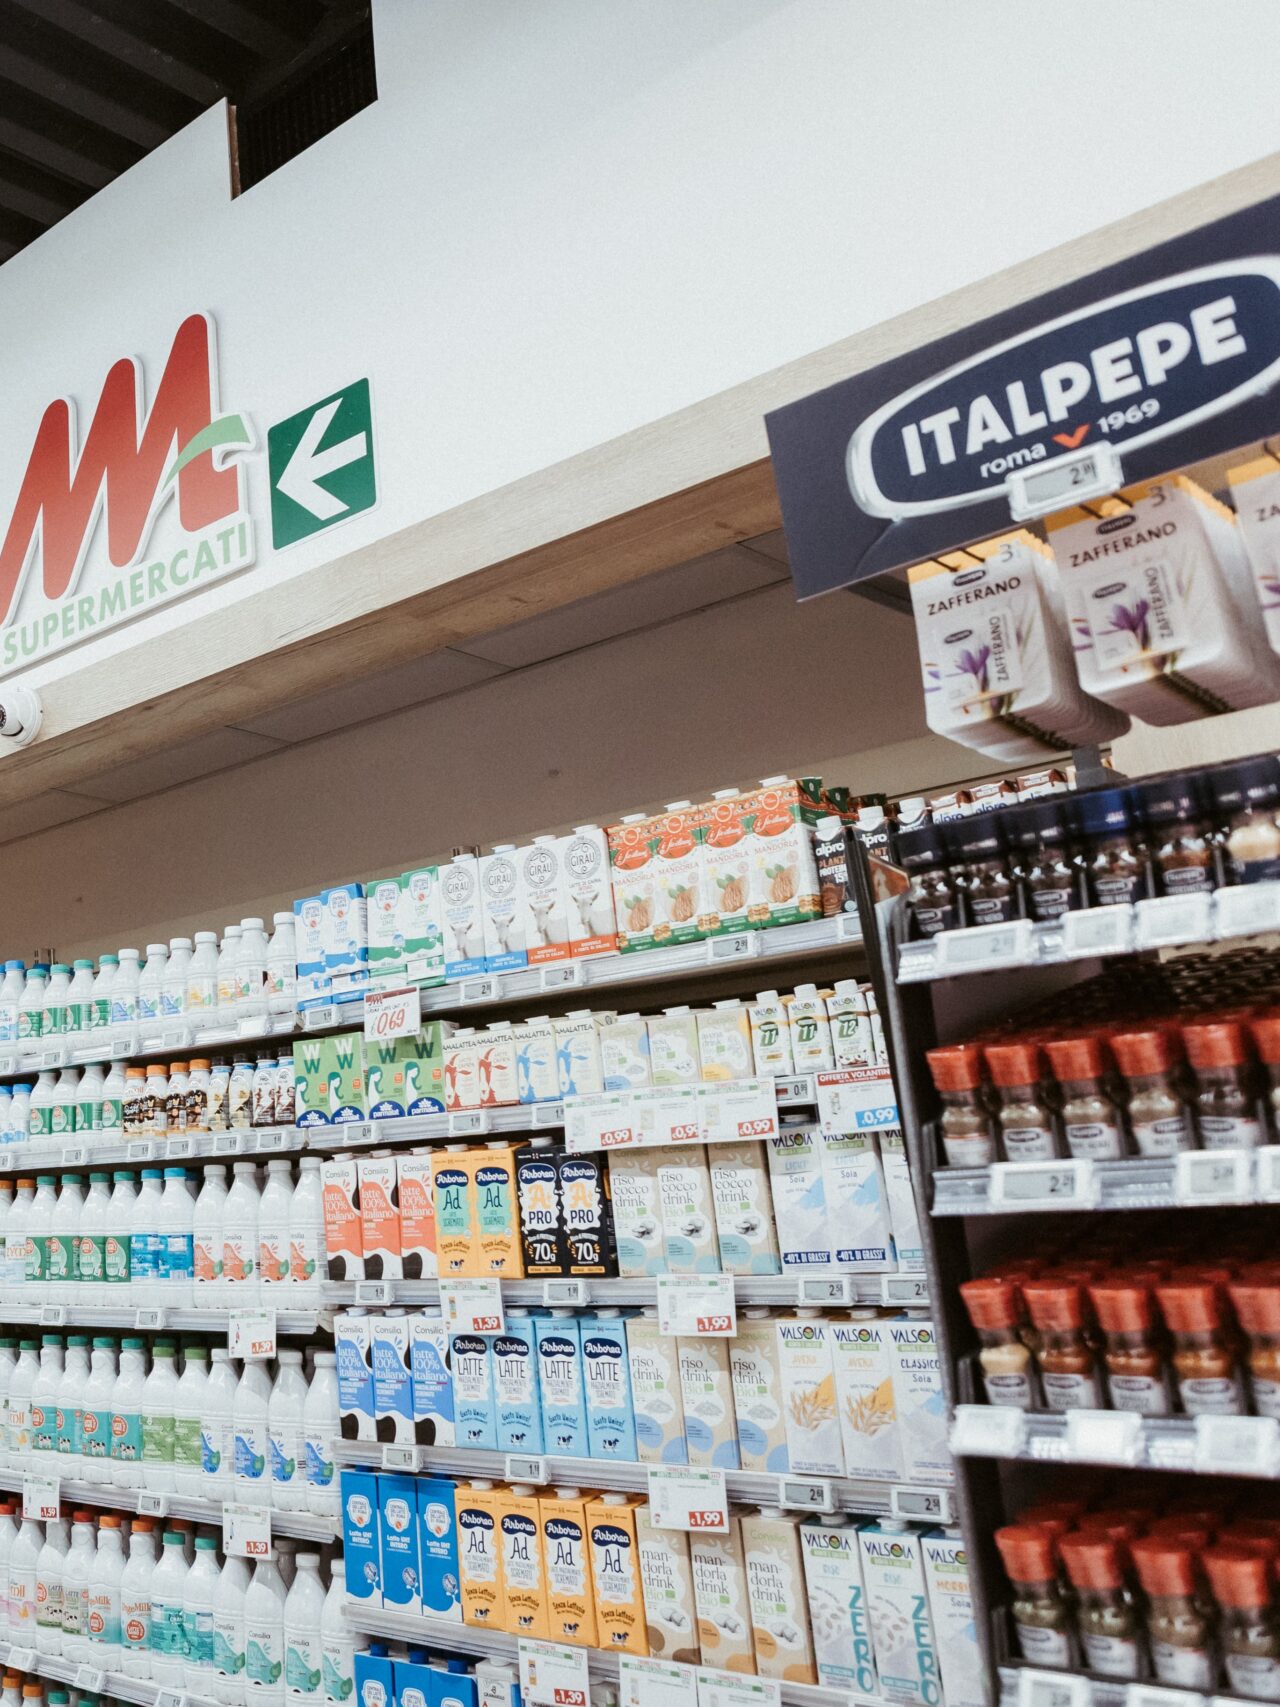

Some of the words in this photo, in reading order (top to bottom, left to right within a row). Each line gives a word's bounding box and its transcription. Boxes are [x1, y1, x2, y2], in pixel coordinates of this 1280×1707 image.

[901, 296, 1247, 476] ITALPEPE
[980, 443, 1048, 478] roma
[1097, 398, 1162, 433] 1969
[1068, 520, 1177, 568] ZAFFERANO
[927, 575, 1021, 616] ZAFFERANO
[1145, 565, 1174, 639] ZAFFERANO
[988, 616, 1010, 683] ZAFFERANO
[815, 841, 845, 857] alpro
[819, 1072, 850, 1083] OFFERTA
[852, 1067, 891, 1079] VOLANTIN
[771, 1132, 813, 1149] VALSOIA
[325, 1169, 349, 1179] Consilia
[362, 1165, 389, 1176] Consilia
[402, 1163, 430, 1173] Consilia
[521, 1167, 554, 1180] Arborea
[562, 1165, 595, 1178] Arborea
[713, 1167, 737, 1180] riso
[436, 1172, 468, 1185] Arborea
[477, 1169, 509, 1182] Arborea
[612, 1174, 635, 1186] riso
[660, 1171, 684, 1182] riso
[613, 1184, 649, 1196] cocco
[661, 1181, 697, 1193] cocco
[714, 1178, 752, 1190] cocco
[324, 1191, 342, 1201] latte
[361, 1189, 381, 1199] latte
[401, 1186, 421, 1196] latte
[716, 1188, 748, 1202] drink
[325, 1200, 348, 1211] 100%
[363, 1198, 386, 1209] 100%
[401, 1195, 426, 1207] 100%
[614, 1194, 646, 1207] drink
[662, 1192, 694, 1206] drink
[326, 1210, 355, 1221] italiano
[363, 1208, 393, 1219] italiano
[401, 1206, 434, 1217] italiano
[528, 1210, 552, 1225] PRO
[570, 1209, 594, 1224] PRO
[338, 1324, 364, 1334] Consilia
[375, 1325, 402, 1335] Consilia
[415, 1325, 444, 1335] Consilia
[780, 1326, 825, 1341] VALSOIA
[833, 1328, 882, 1343] VALSOIA
[454, 1339, 486, 1351] Arborea
[495, 1341, 528, 1353] Arborea
[541, 1341, 574, 1354] Arborea
[585, 1342, 621, 1355] Arborea
[338, 1346, 356, 1358] latte
[374, 1346, 393, 1358] latte
[413, 1347, 433, 1359] latte
[339, 1357, 361, 1368] 100%
[375, 1357, 399, 1369] 100%
[414, 1358, 440, 1370] 100%
[457, 1357, 484, 1378] LATTE
[632, 1356, 654, 1368] riso
[681, 1358, 704, 1370] riso
[732, 1359, 756, 1371] riso
[339, 1367, 368, 1379] italiano
[375, 1368, 407, 1380] italiano
[414, 1369, 448, 1381] italiano
[498, 1359, 525, 1379] LATTE
[543, 1360, 572, 1380] LATTE
[588, 1362, 619, 1382] LATTE
[633, 1367, 664, 1382] drink
[682, 1369, 713, 1383] drink
[734, 1371, 767, 1386] drink
[912, 1374, 932, 1384] Soia
[459, 1512, 494, 1527] Arborea
[502, 1517, 536, 1533] Arborea
[546, 1522, 582, 1537] Arborea
[468, 1531, 487, 1554] Ad
[593, 1529, 631, 1545] Arborea
[804, 1533, 851, 1551] VALSOIA
[510, 1537, 530, 1561] Ad
[554, 1542, 575, 1566] Ad
[863, 1541, 914, 1560] VALSOIA
[602, 1549, 624, 1574] Ad
[641, 1550, 672, 1562] man-
[694, 1553, 726, 1567] man-
[643, 1562, 673, 1576] dorla
[749, 1560, 783, 1573] man-
[695, 1566, 727, 1581] dorla
[644, 1575, 674, 1590] drink
[696, 1580, 729, 1595] drink
[750, 1574, 783, 1588] dorla
[752, 1587, 785, 1602] drink
[288, 1637, 310, 1647] Consilia
[848, 1585, 874, 1693] ZERO
[911, 1595, 940, 1706] ZERO
